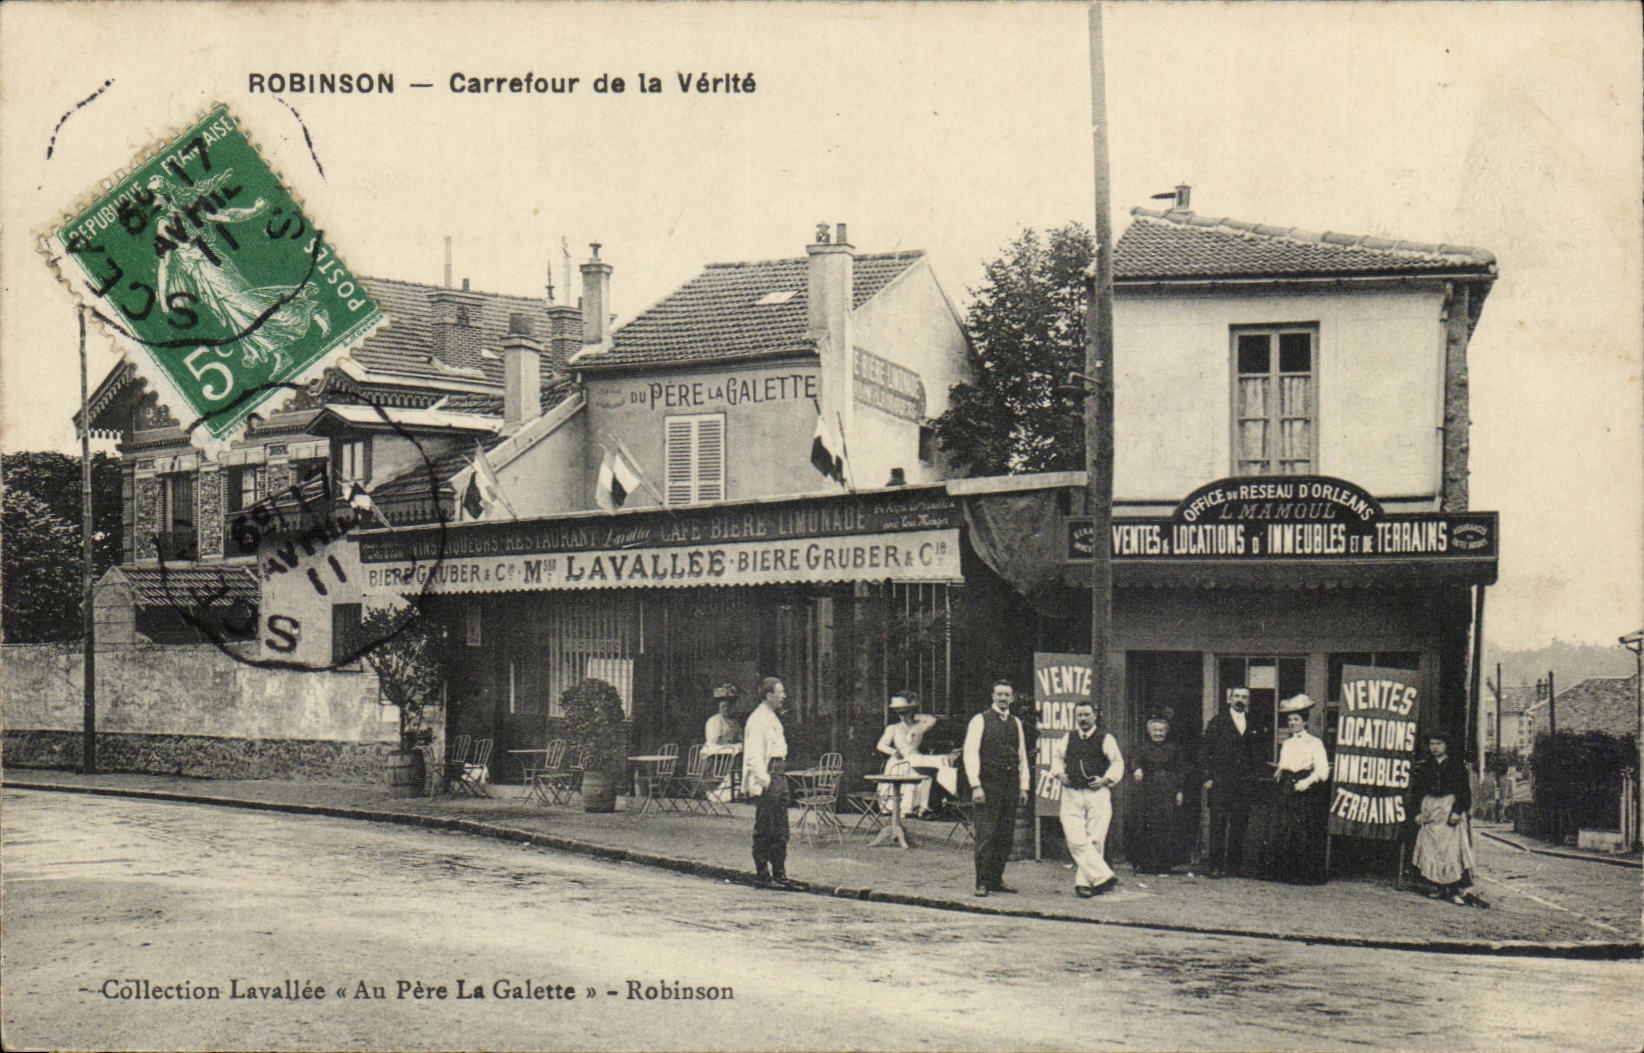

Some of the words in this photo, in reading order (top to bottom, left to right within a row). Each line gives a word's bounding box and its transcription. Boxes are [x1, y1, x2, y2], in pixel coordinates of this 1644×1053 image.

[303, 236, 366, 312] POSTES
[630, 391, 647, 404] DU
[708, 386, 723, 399] LA
[726, 374, 818, 405] GALETTE
[1183, 489, 1226, 521] OFFICE
[1239, 484, 1294, 500] RESEAU
[1299, 482, 1375, 521] D'ORLEANS
[1238, 502, 1336, 519] MAMOUL
[506, 527, 596, 550] RESTAURANT
[778, 504, 866, 536] LIMONADE
[1112, 524, 1161, 555] VENTES
[1172, 524, 1246, 555] LOCATIONS
[1267, 523, 1346, 555] IMMEUBLES
[1350, 535, 1360, 553] ET
[1375, 521, 1448, 554] TERRAINS
[737, 547, 800, 573] BIERE
[805, 543, 900, 571] GRUBER
[904, 550, 913, 567] &
[1343, 680, 1417, 716] VENTES
[1337, 716, 1417, 752] LOCATIONS
[1333, 753, 1412, 788] IMMEUBLES
[1330, 787, 1407, 824] TERRAINS
